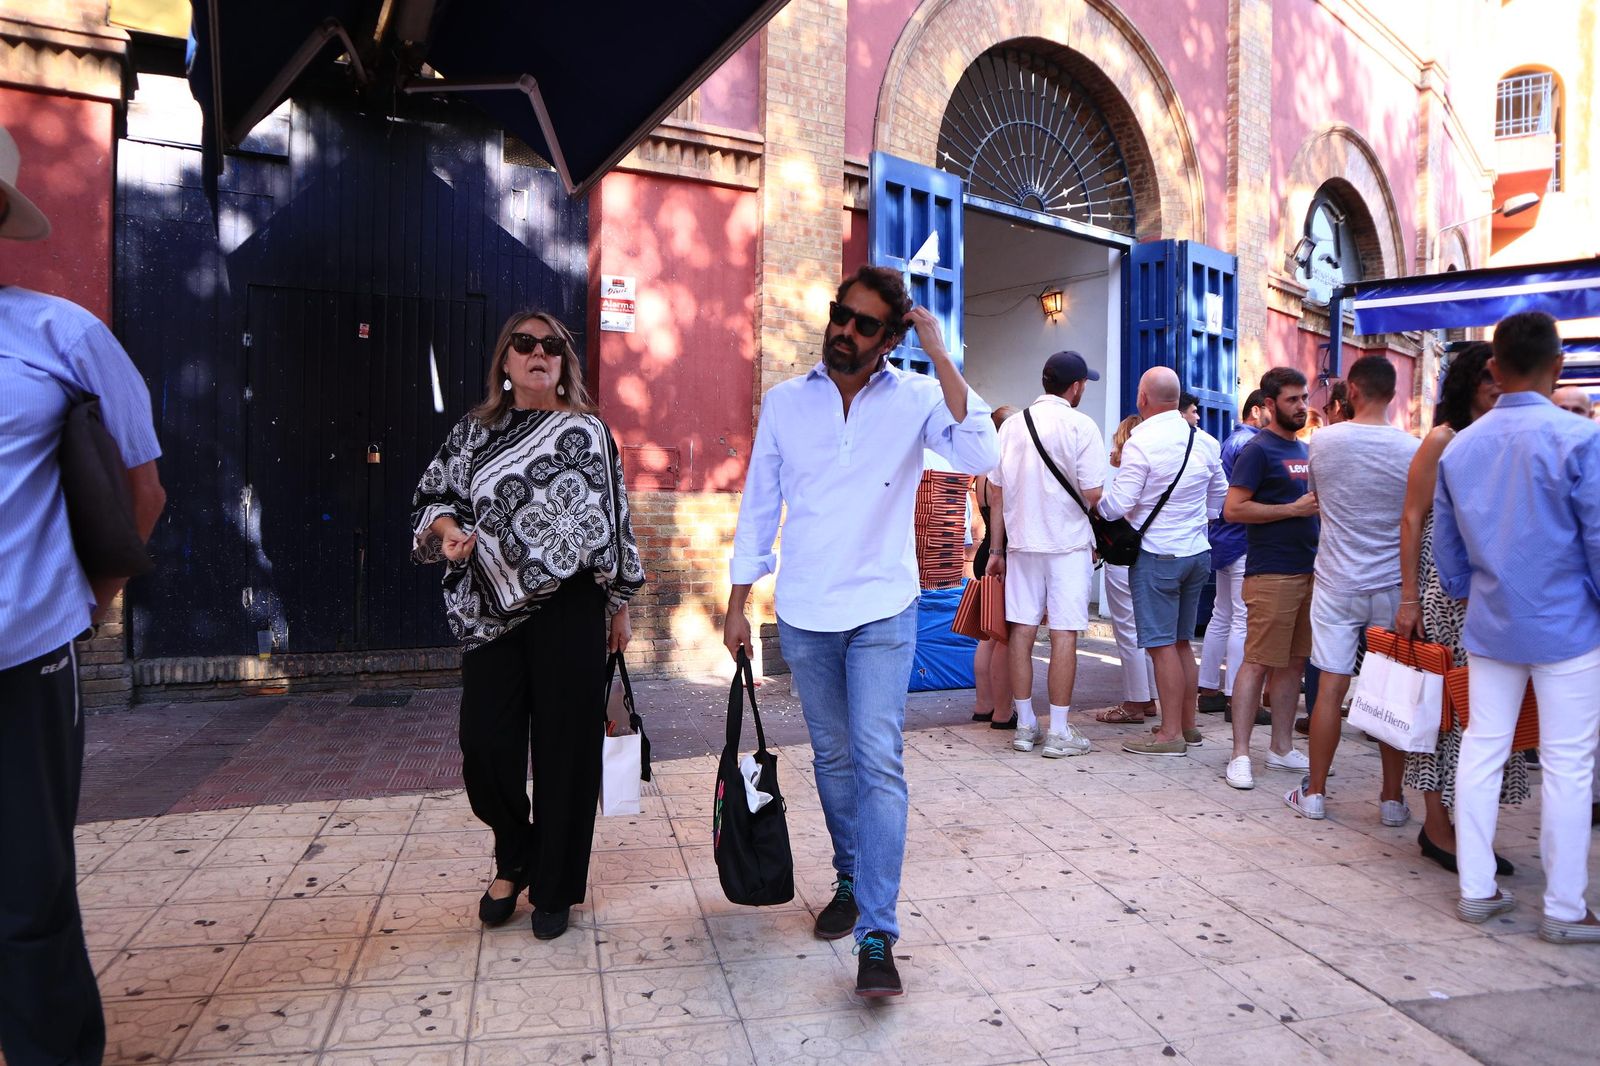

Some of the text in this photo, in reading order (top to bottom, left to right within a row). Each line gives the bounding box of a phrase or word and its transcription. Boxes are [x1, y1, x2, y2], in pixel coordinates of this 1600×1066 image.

[602, 299, 634, 310] Alarma
[1355, 696, 1410, 731] Pedro del Hierro
